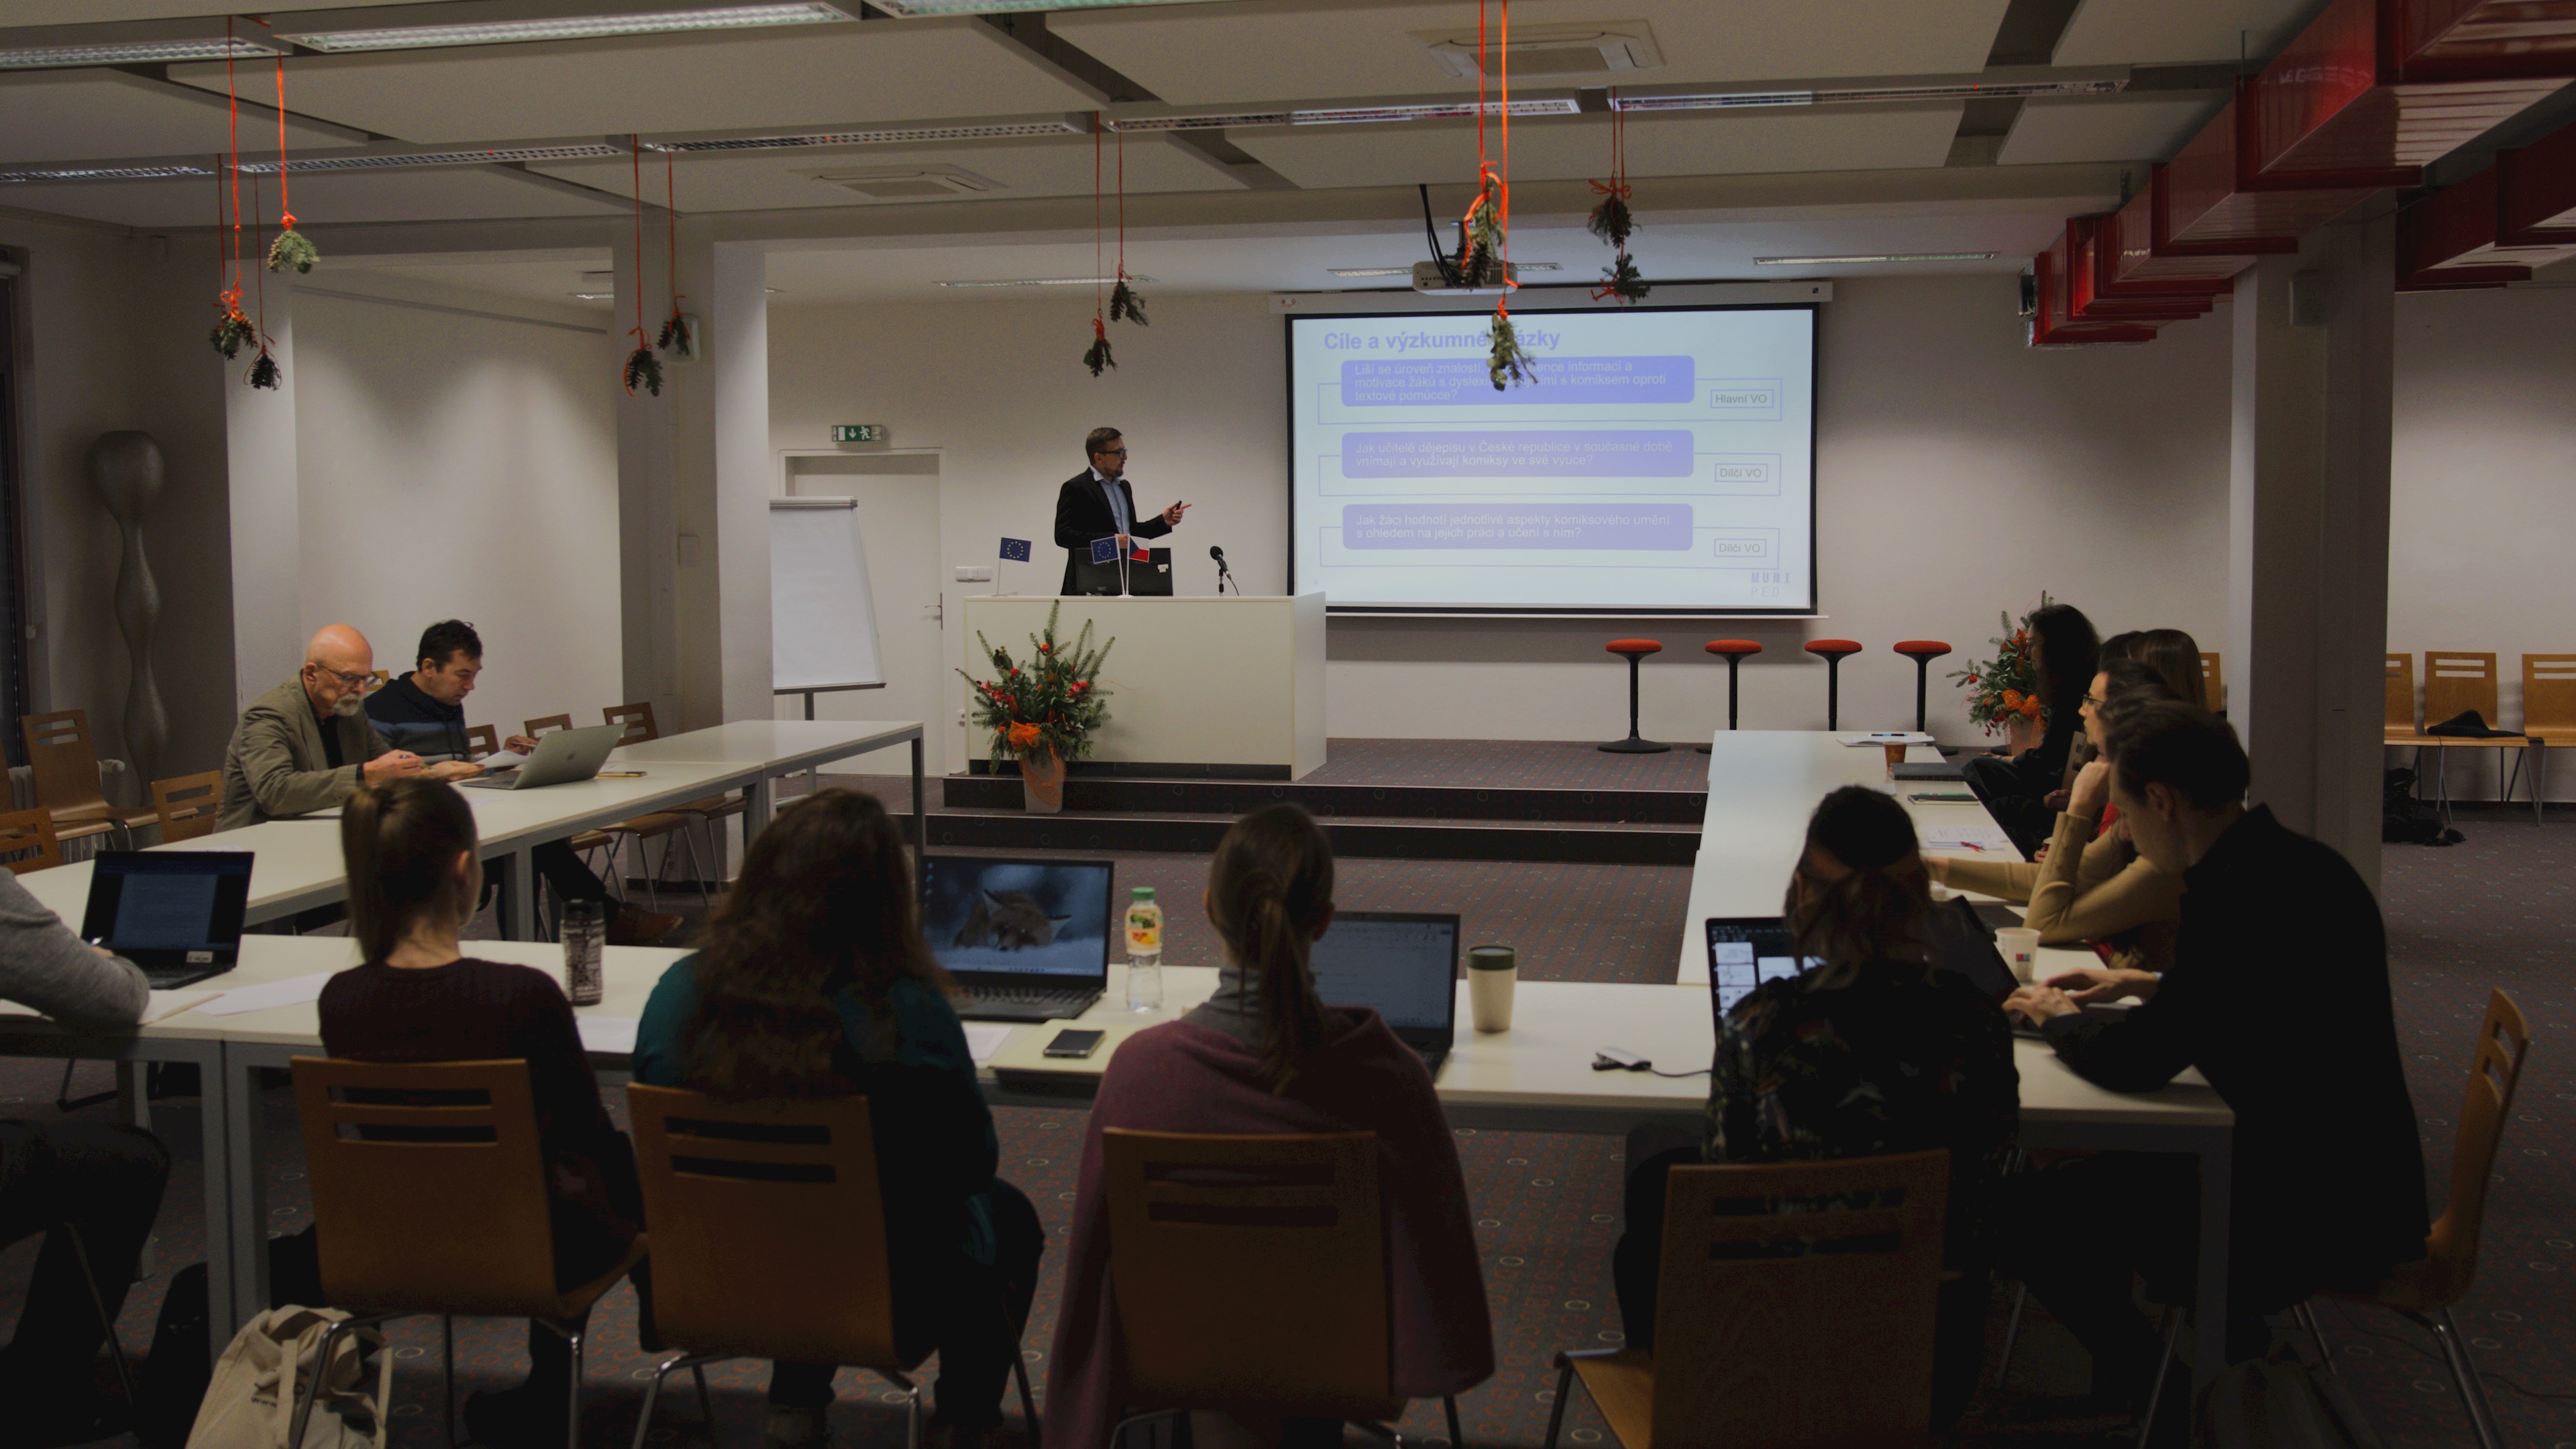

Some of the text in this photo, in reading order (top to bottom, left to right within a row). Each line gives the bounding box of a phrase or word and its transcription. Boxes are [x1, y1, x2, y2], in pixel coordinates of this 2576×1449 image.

[1324, 332, 1362, 350] Cíle
[1368, 335, 1379, 349] a
[1385, 331, 1488, 353] výzkumné
[1378, 366, 1391, 374] se
[1395, 363, 1434, 374] úroveň
[1625, 363, 1632, 372] a
[1355, 378, 1405, 388] motivace
[1439, 378, 1446, 386] s
[1560, 377, 1567, 385] s
[1570, 374, 1629, 385] komiksem
[1633, 374, 1666, 386] oproti
[1355, 390, 1396, 401] textové
[1715, 393, 1767, 405] Hlavní VO
[1355, 443, 1375, 454] Jak
[1379, 442, 1415, 453] učitelé
[1418, 441, 1465, 455] dějepisu
[1479, 439, 1514, 452] České
[1519, 441, 1570, 454] republice
[1574, 443, 1580, 451] v
[1584, 440, 1640, 451] současné
[1644, 440, 1672, 451] době
[1399, 458, 1407, 466] a
[1410, 454, 1459, 468] využívají
[1462, 455, 1509, 468] komiksy
[1512, 457, 1525, 465] ve
[1529, 455, 1548, 465] své
[1552, 454, 1593, 468] výuce?
[1719, 467, 1762, 478] Dílčí VO
[1356, 513, 1670, 527] Jak žáci hodnotí jednotlivé aspekty komiksového umění
[1366, 528, 1413, 537] ohledem
[1466, 527, 1494, 539] práci
[1508, 527, 1540, 537] učení
[1543, 529, 1550, 537] s
[1553, 527, 1581, 537] ním?
[1719, 542, 1761, 553] Dílčí VO
[1751, 572, 1790, 584] MUNI
[1750, 586, 1780, 597] PED
